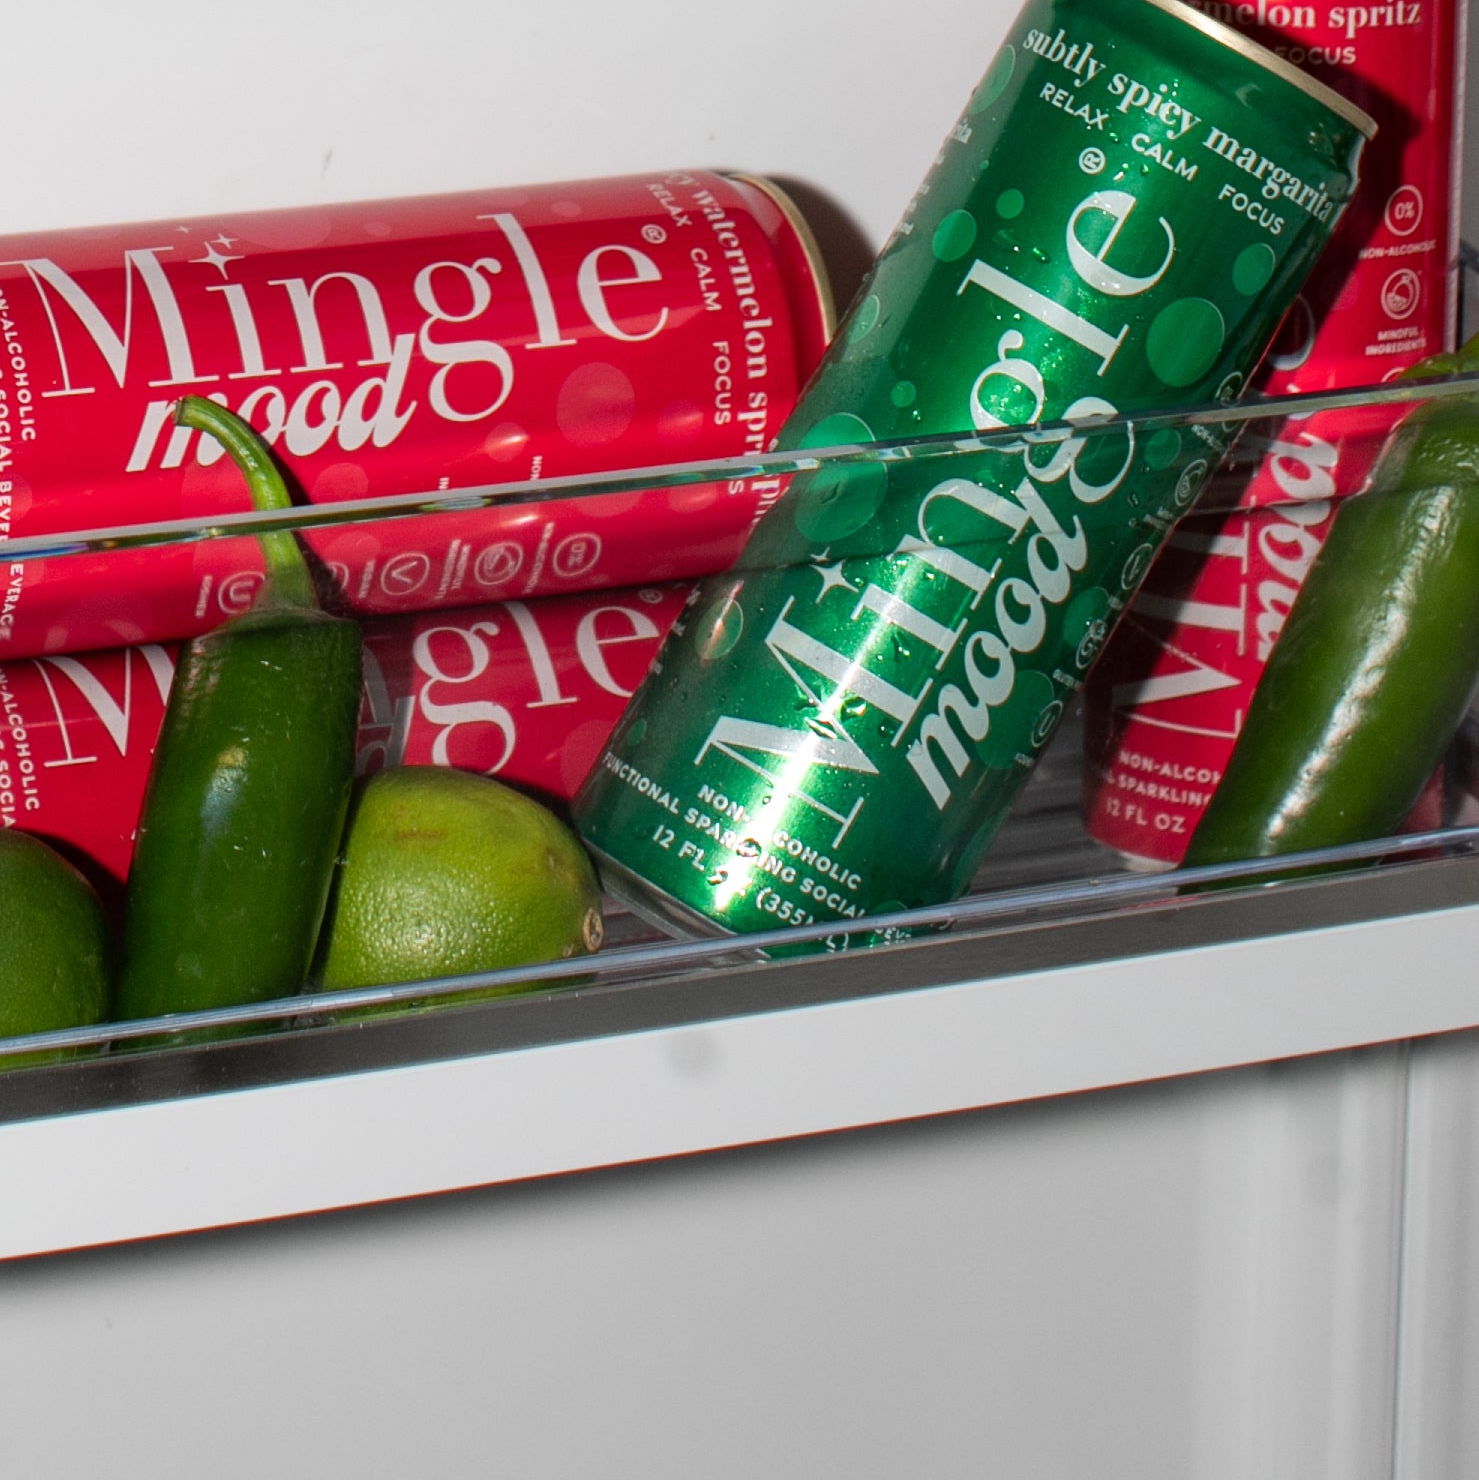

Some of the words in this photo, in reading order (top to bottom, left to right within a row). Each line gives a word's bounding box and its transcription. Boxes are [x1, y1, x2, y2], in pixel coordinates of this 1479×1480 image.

[1021, 24, 1108, 88] subtly
[1105, 65, 1203, 141] spicy
[1202, 122, 1335, 223] margarita
[1272, 45, 1357, 65] FOCUS
[1039, 81, 1110, 132] RELAX
[1130, 131, 1200, 183] CALM
[1217, 183, 1286, 237] FOCUS
[1393, 201, 1415, 221] 0%
[646, 182, 693, 228] RELAX
[688, 247, 722, 313] CALM
[711, 339, 732, 426] FOCUS
[691, 185, 774, 381] watermelon
[125, 333, 418, 472] mood
[904, 472, 1090, 812] mood
[601, 750, 681, 815] FUNCTIONAL
[684, 807, 797, 885] SPARING
[652, 824, 676, 850] 12
[677, 840, 707, 872] FL
[696, 783, 863, 891] NON-COHOLIC
[1105, 797, 1120, 817] 12
[1124, 804, 1148, 826] FL
[1153, 813, 1187, 834] OZ
